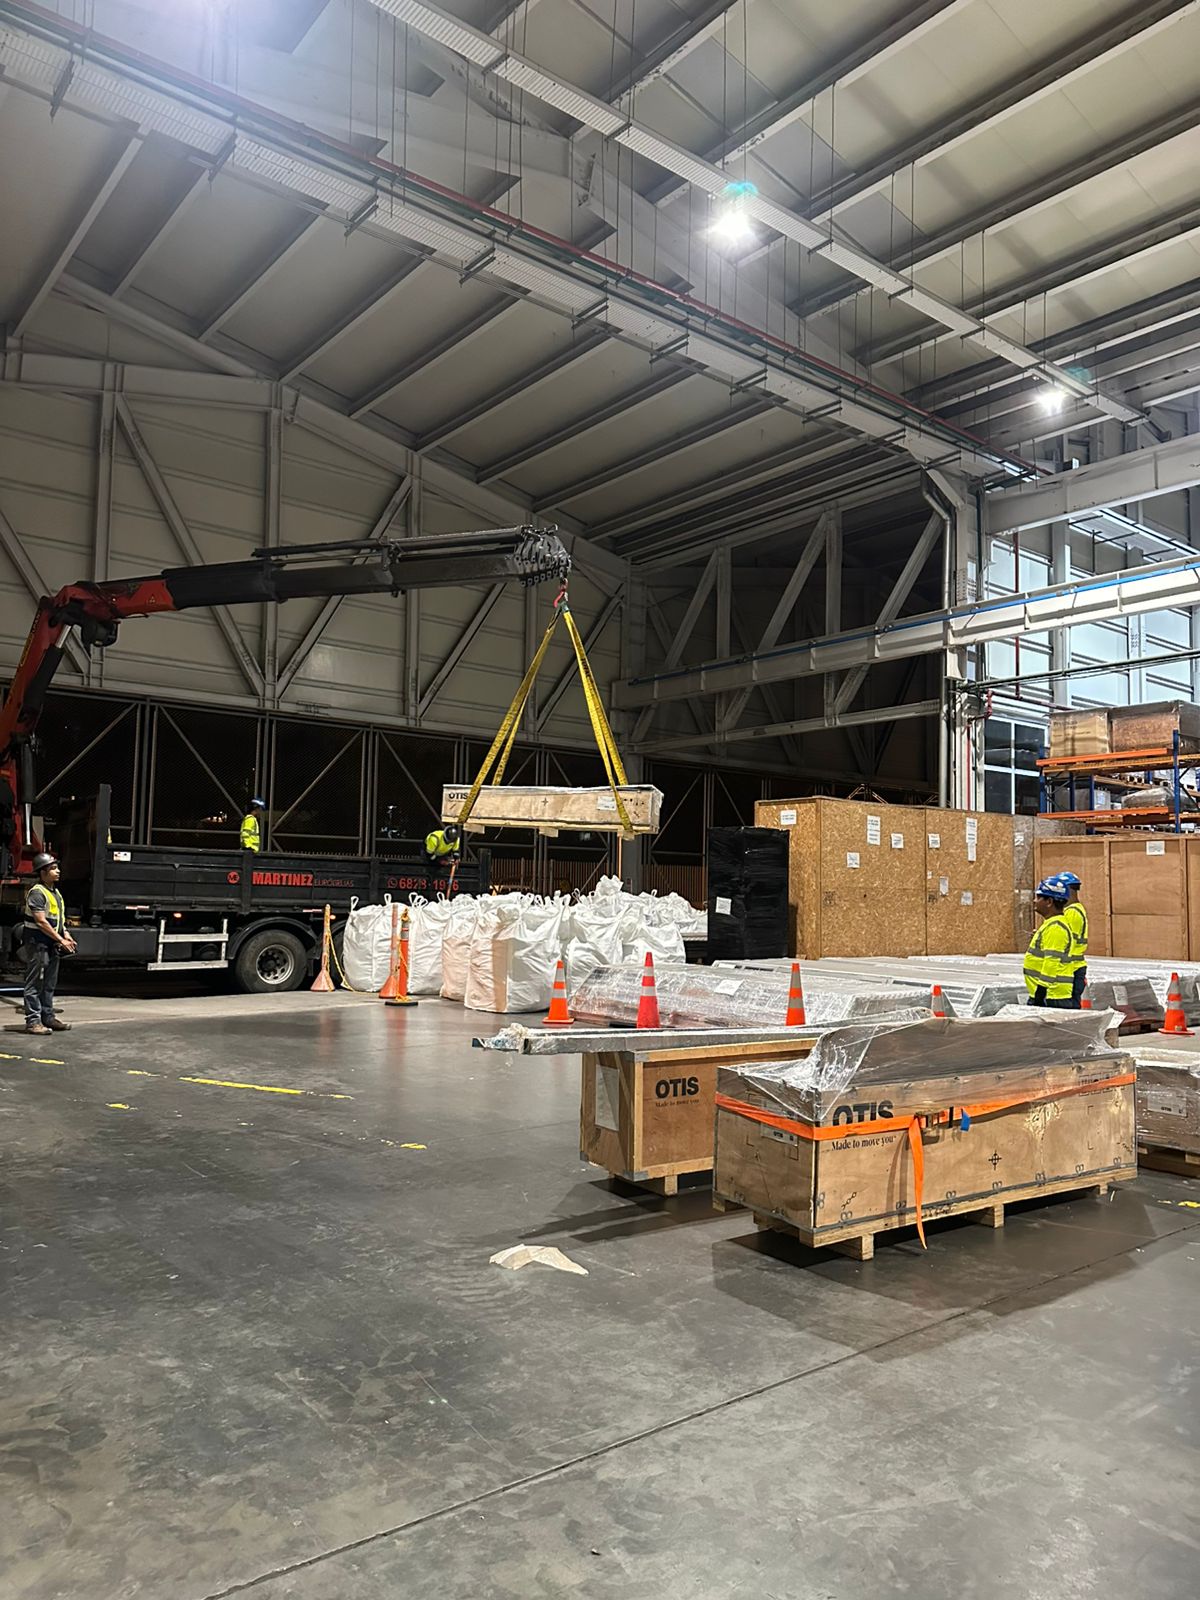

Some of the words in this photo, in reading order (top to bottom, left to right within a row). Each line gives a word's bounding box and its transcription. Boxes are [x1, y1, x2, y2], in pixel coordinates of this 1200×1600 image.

[448, 792, 469, 800] OTIS
[252, 871, 313, 886] MARTINEZ
[399, 878, 459, 891] 6828-196
[655, 1076, 699, 1099] OTIS
[832, 1100, 894, 1127] OTIS
[831, 1139, 851, 1151] Made
[852, 1139, 860, 1149] to
[861, 1138, 880, 1148] move
